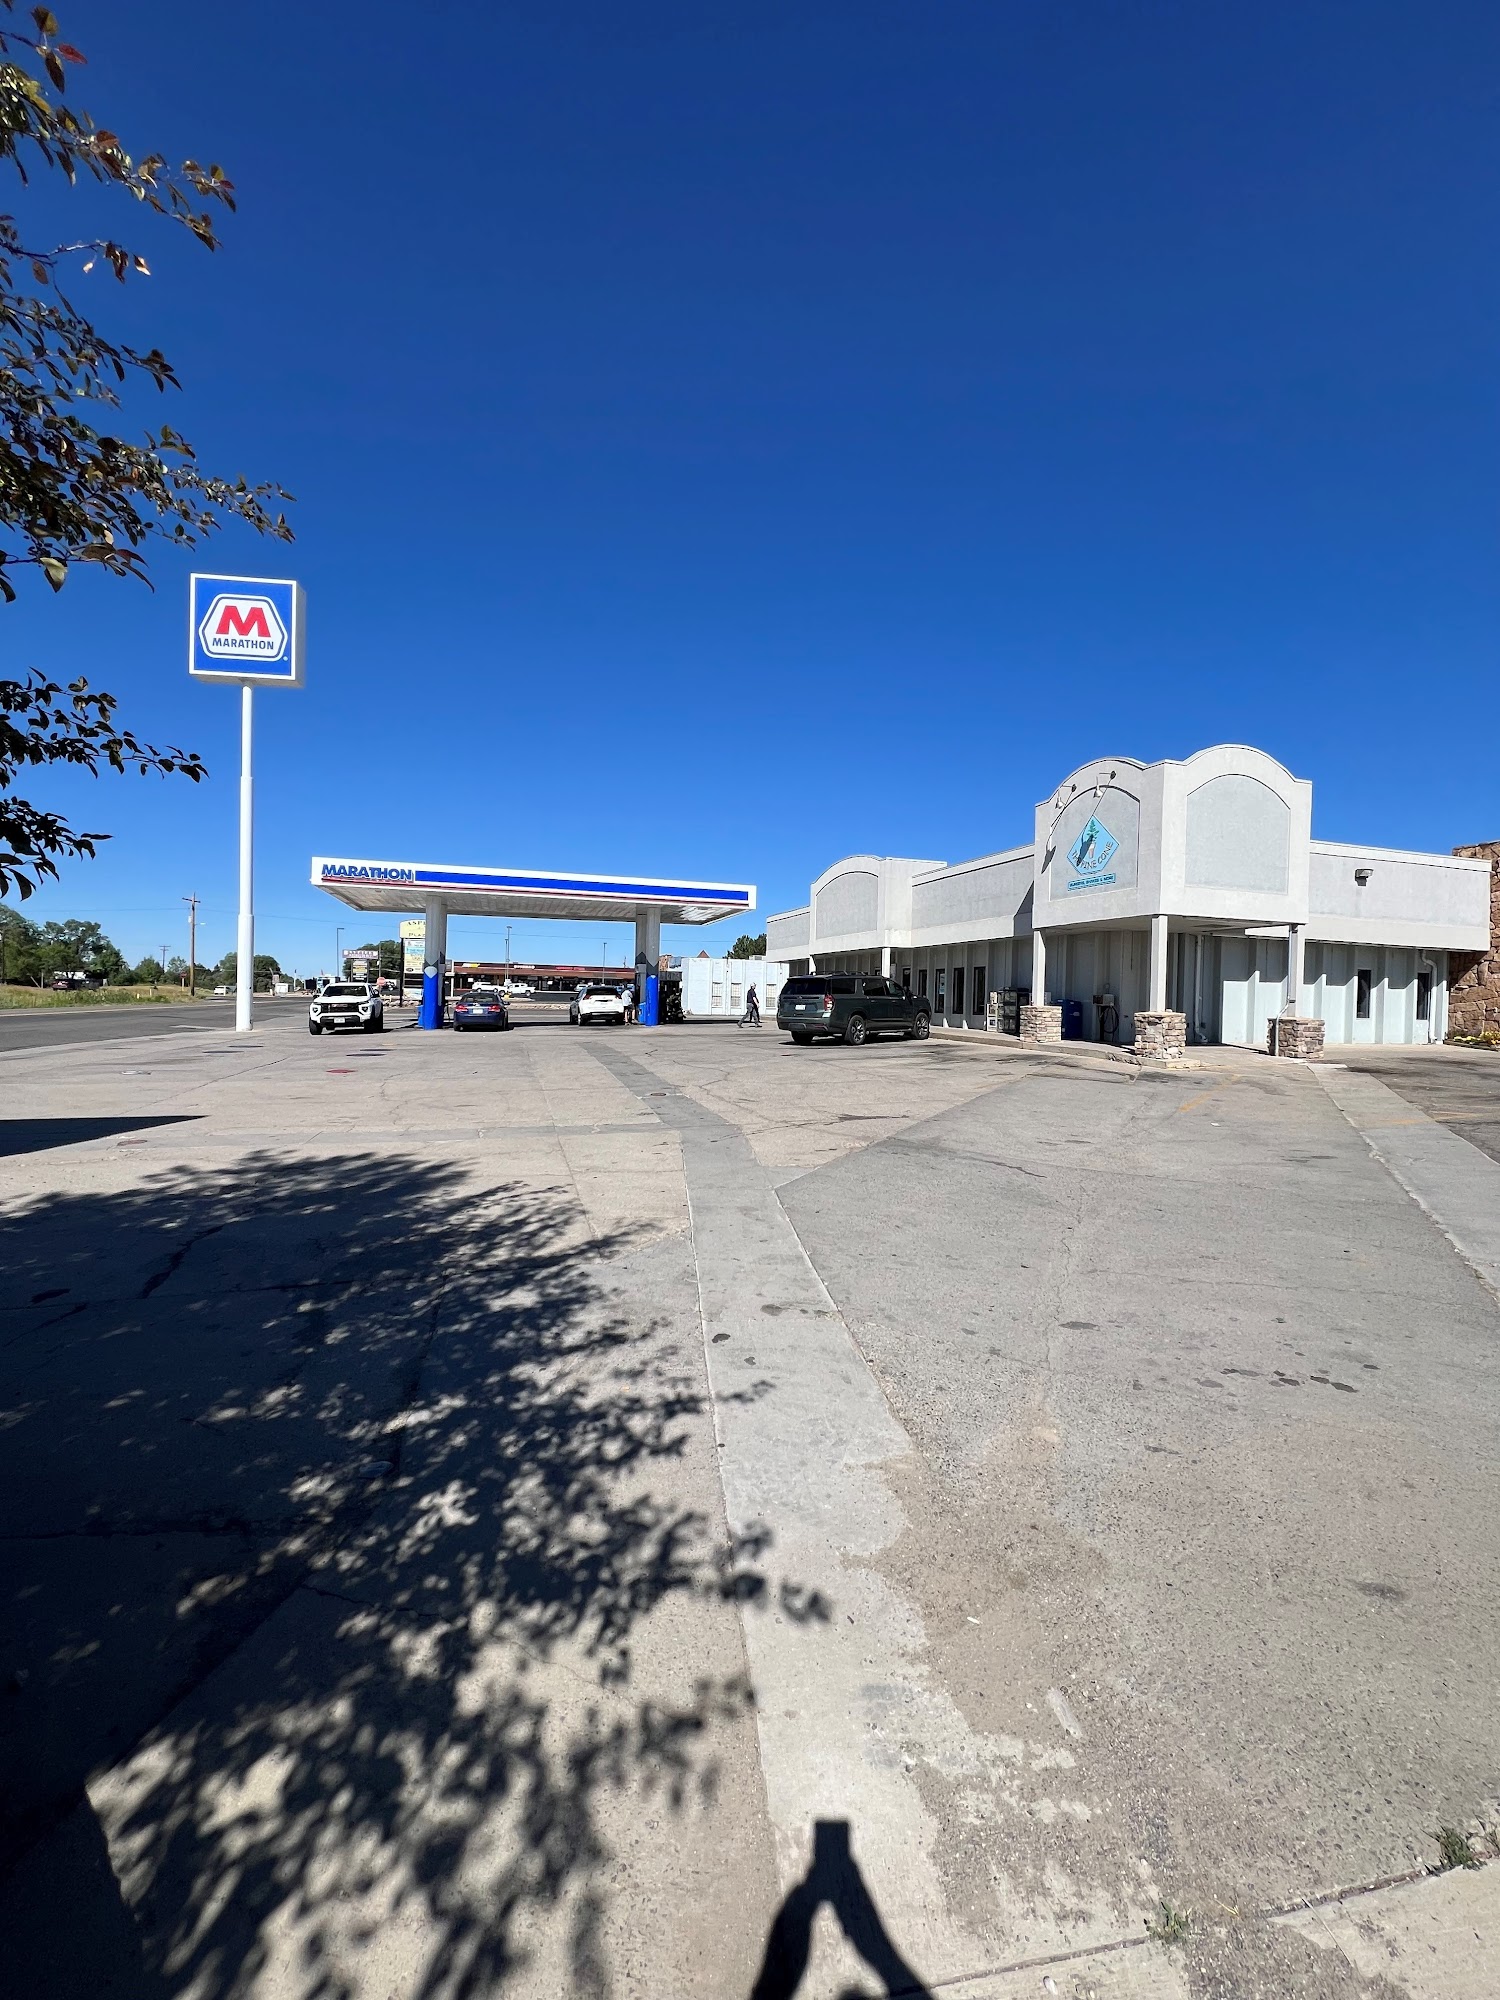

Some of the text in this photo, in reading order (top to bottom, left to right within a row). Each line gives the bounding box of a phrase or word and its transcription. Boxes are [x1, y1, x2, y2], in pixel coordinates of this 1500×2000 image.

[216, 605, 271, 637] M
[212, 637, 274, 650] MARATHON
[1097, 841, 1113, 864] CONE
[321, 863, 413, 881] MARATHON
